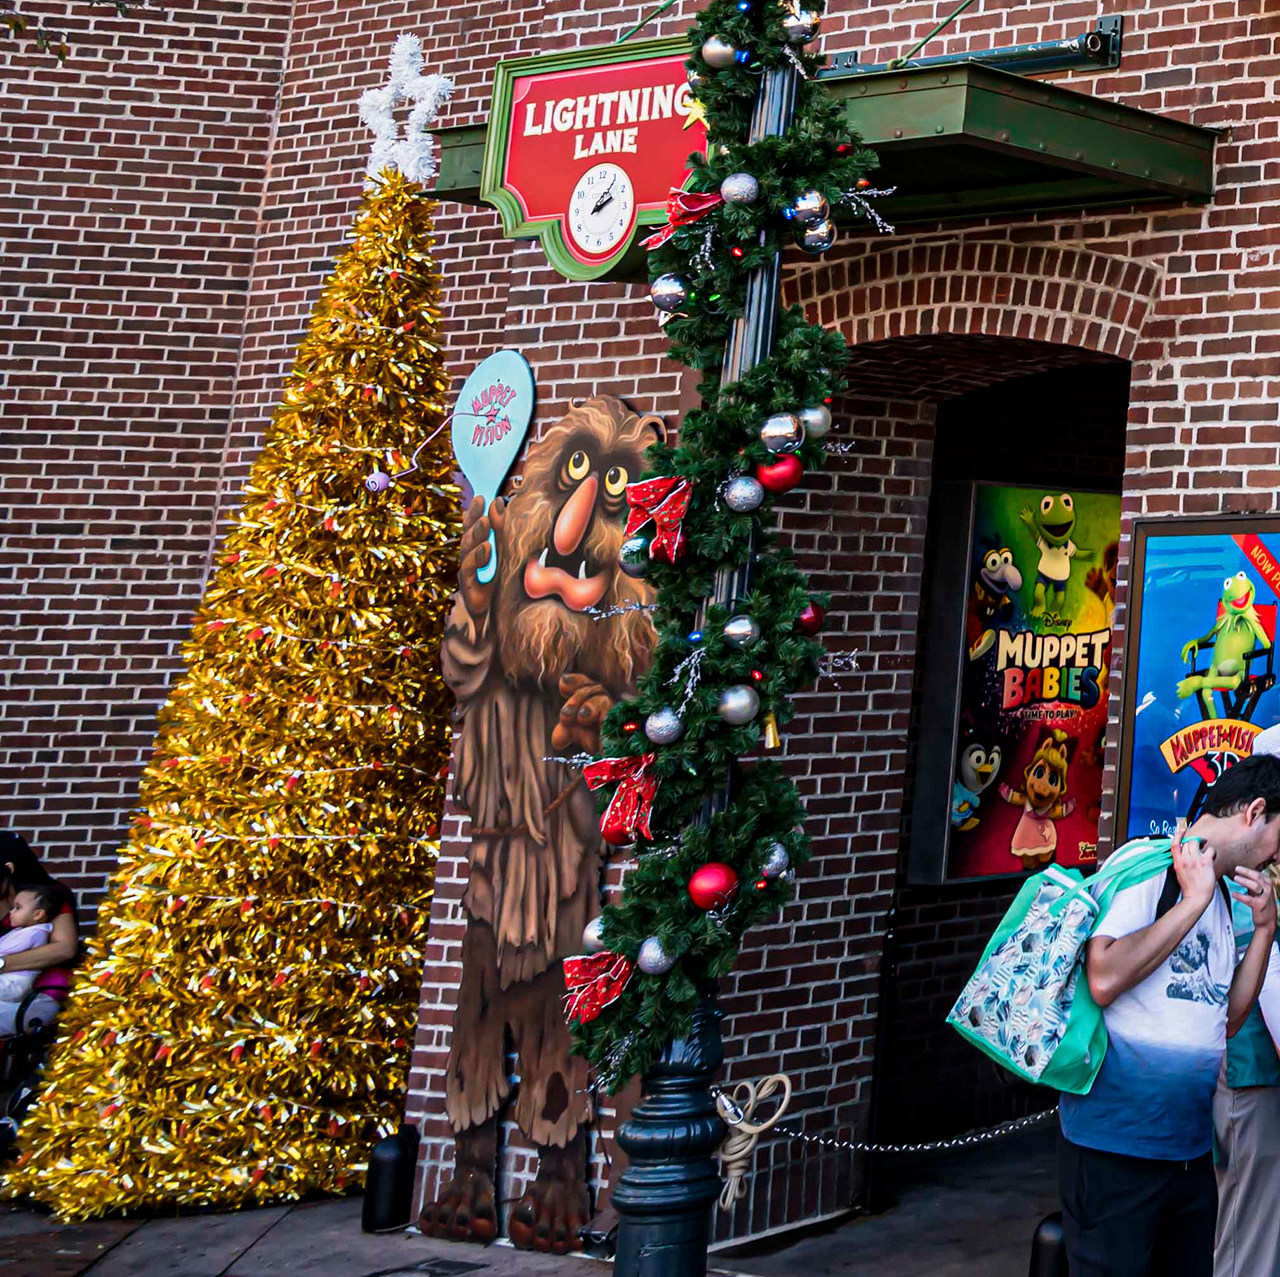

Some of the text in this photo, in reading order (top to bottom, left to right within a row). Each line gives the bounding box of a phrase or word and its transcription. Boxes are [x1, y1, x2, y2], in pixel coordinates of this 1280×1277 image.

[573, 127, 638, 160] LANE
[471, 383, 517, 417] MUPPET
[472, 414, 512, 447] VISION
[1250, 545, 1275, 574] NOW
[996, 628, 1111, 671] MUPPET
[1002, 666, 1099, 709] BABIES
[1025, 710, 1042, 720] TIME
[1045, 710, 1054, 719] TO
[1228, 725, 1254, 753] VISI
